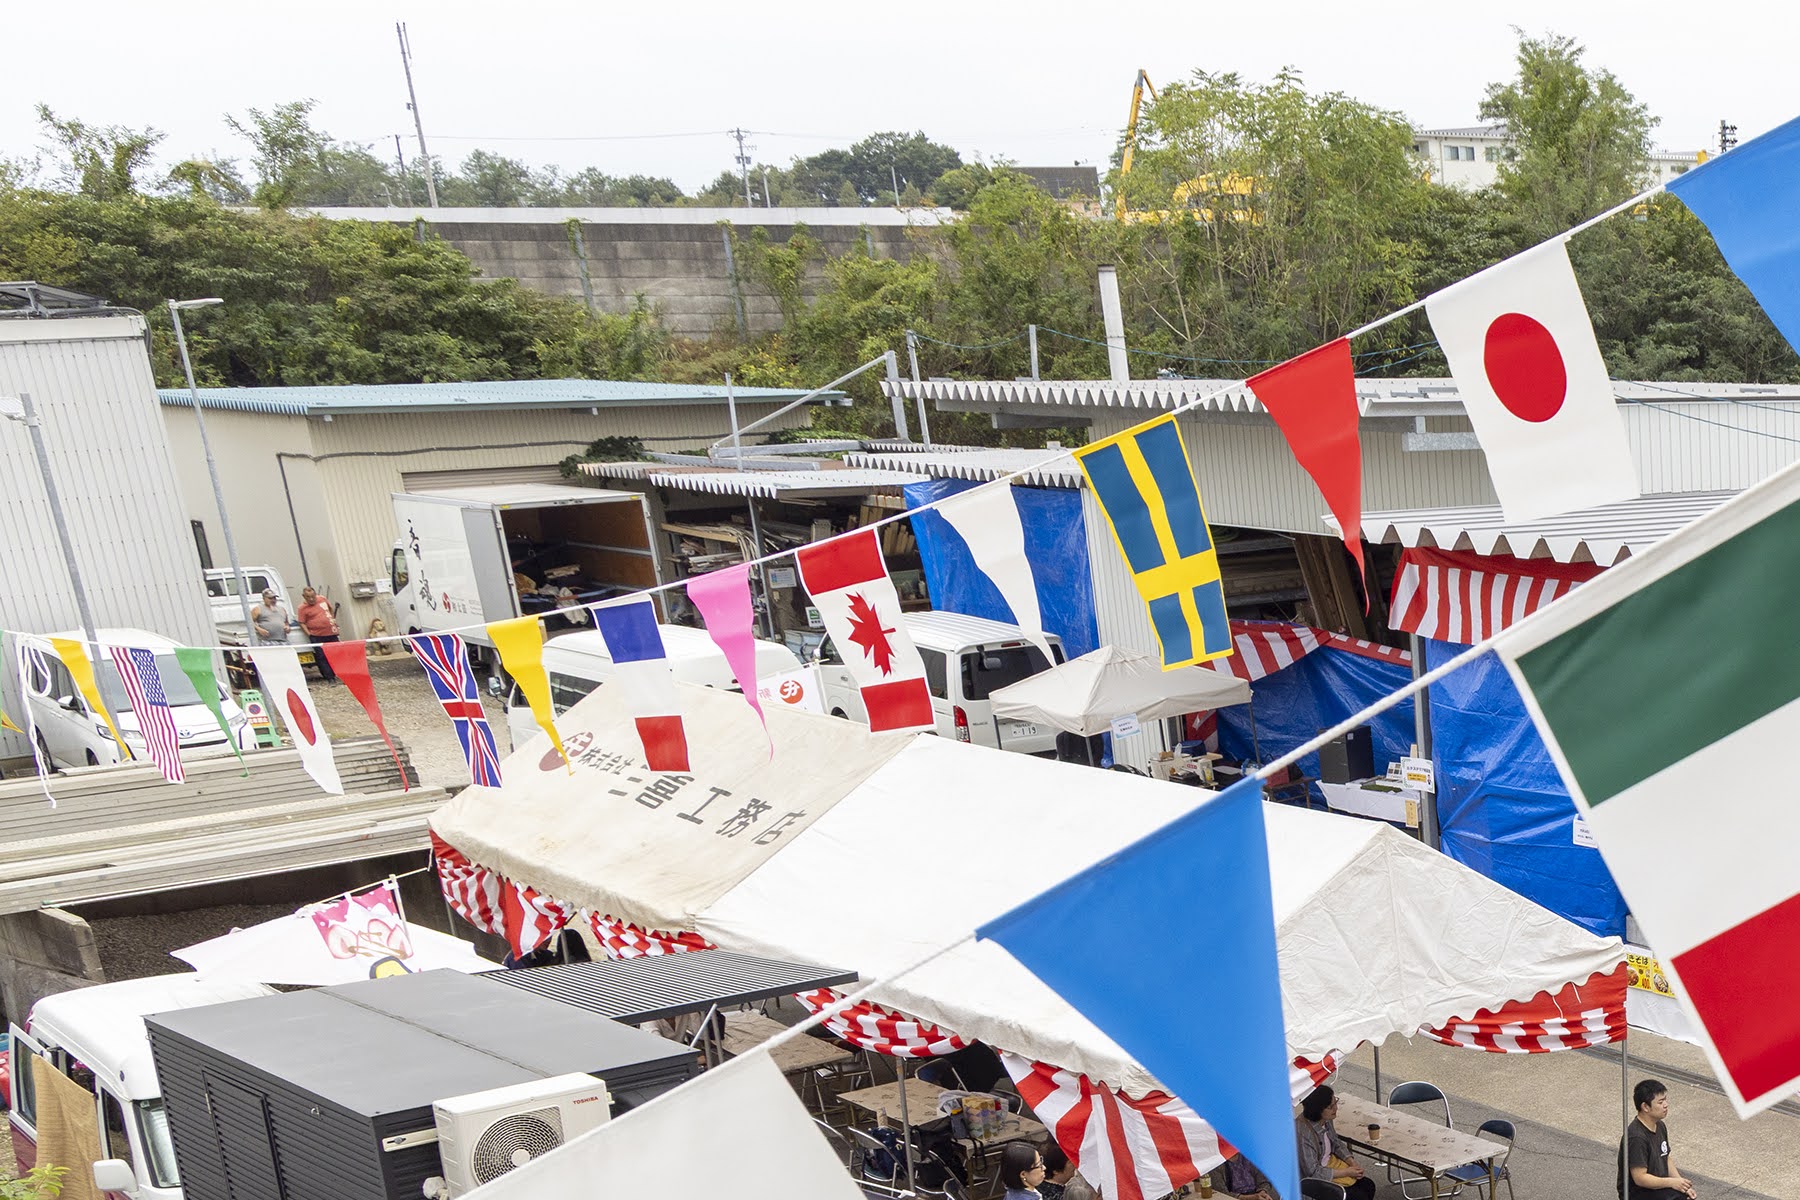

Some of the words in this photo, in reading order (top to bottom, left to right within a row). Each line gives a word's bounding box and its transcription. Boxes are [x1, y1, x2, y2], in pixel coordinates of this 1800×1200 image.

[577, 745, 635, 776] 株式会社
[573, 1096, 599, 1105] TOSHIBA
